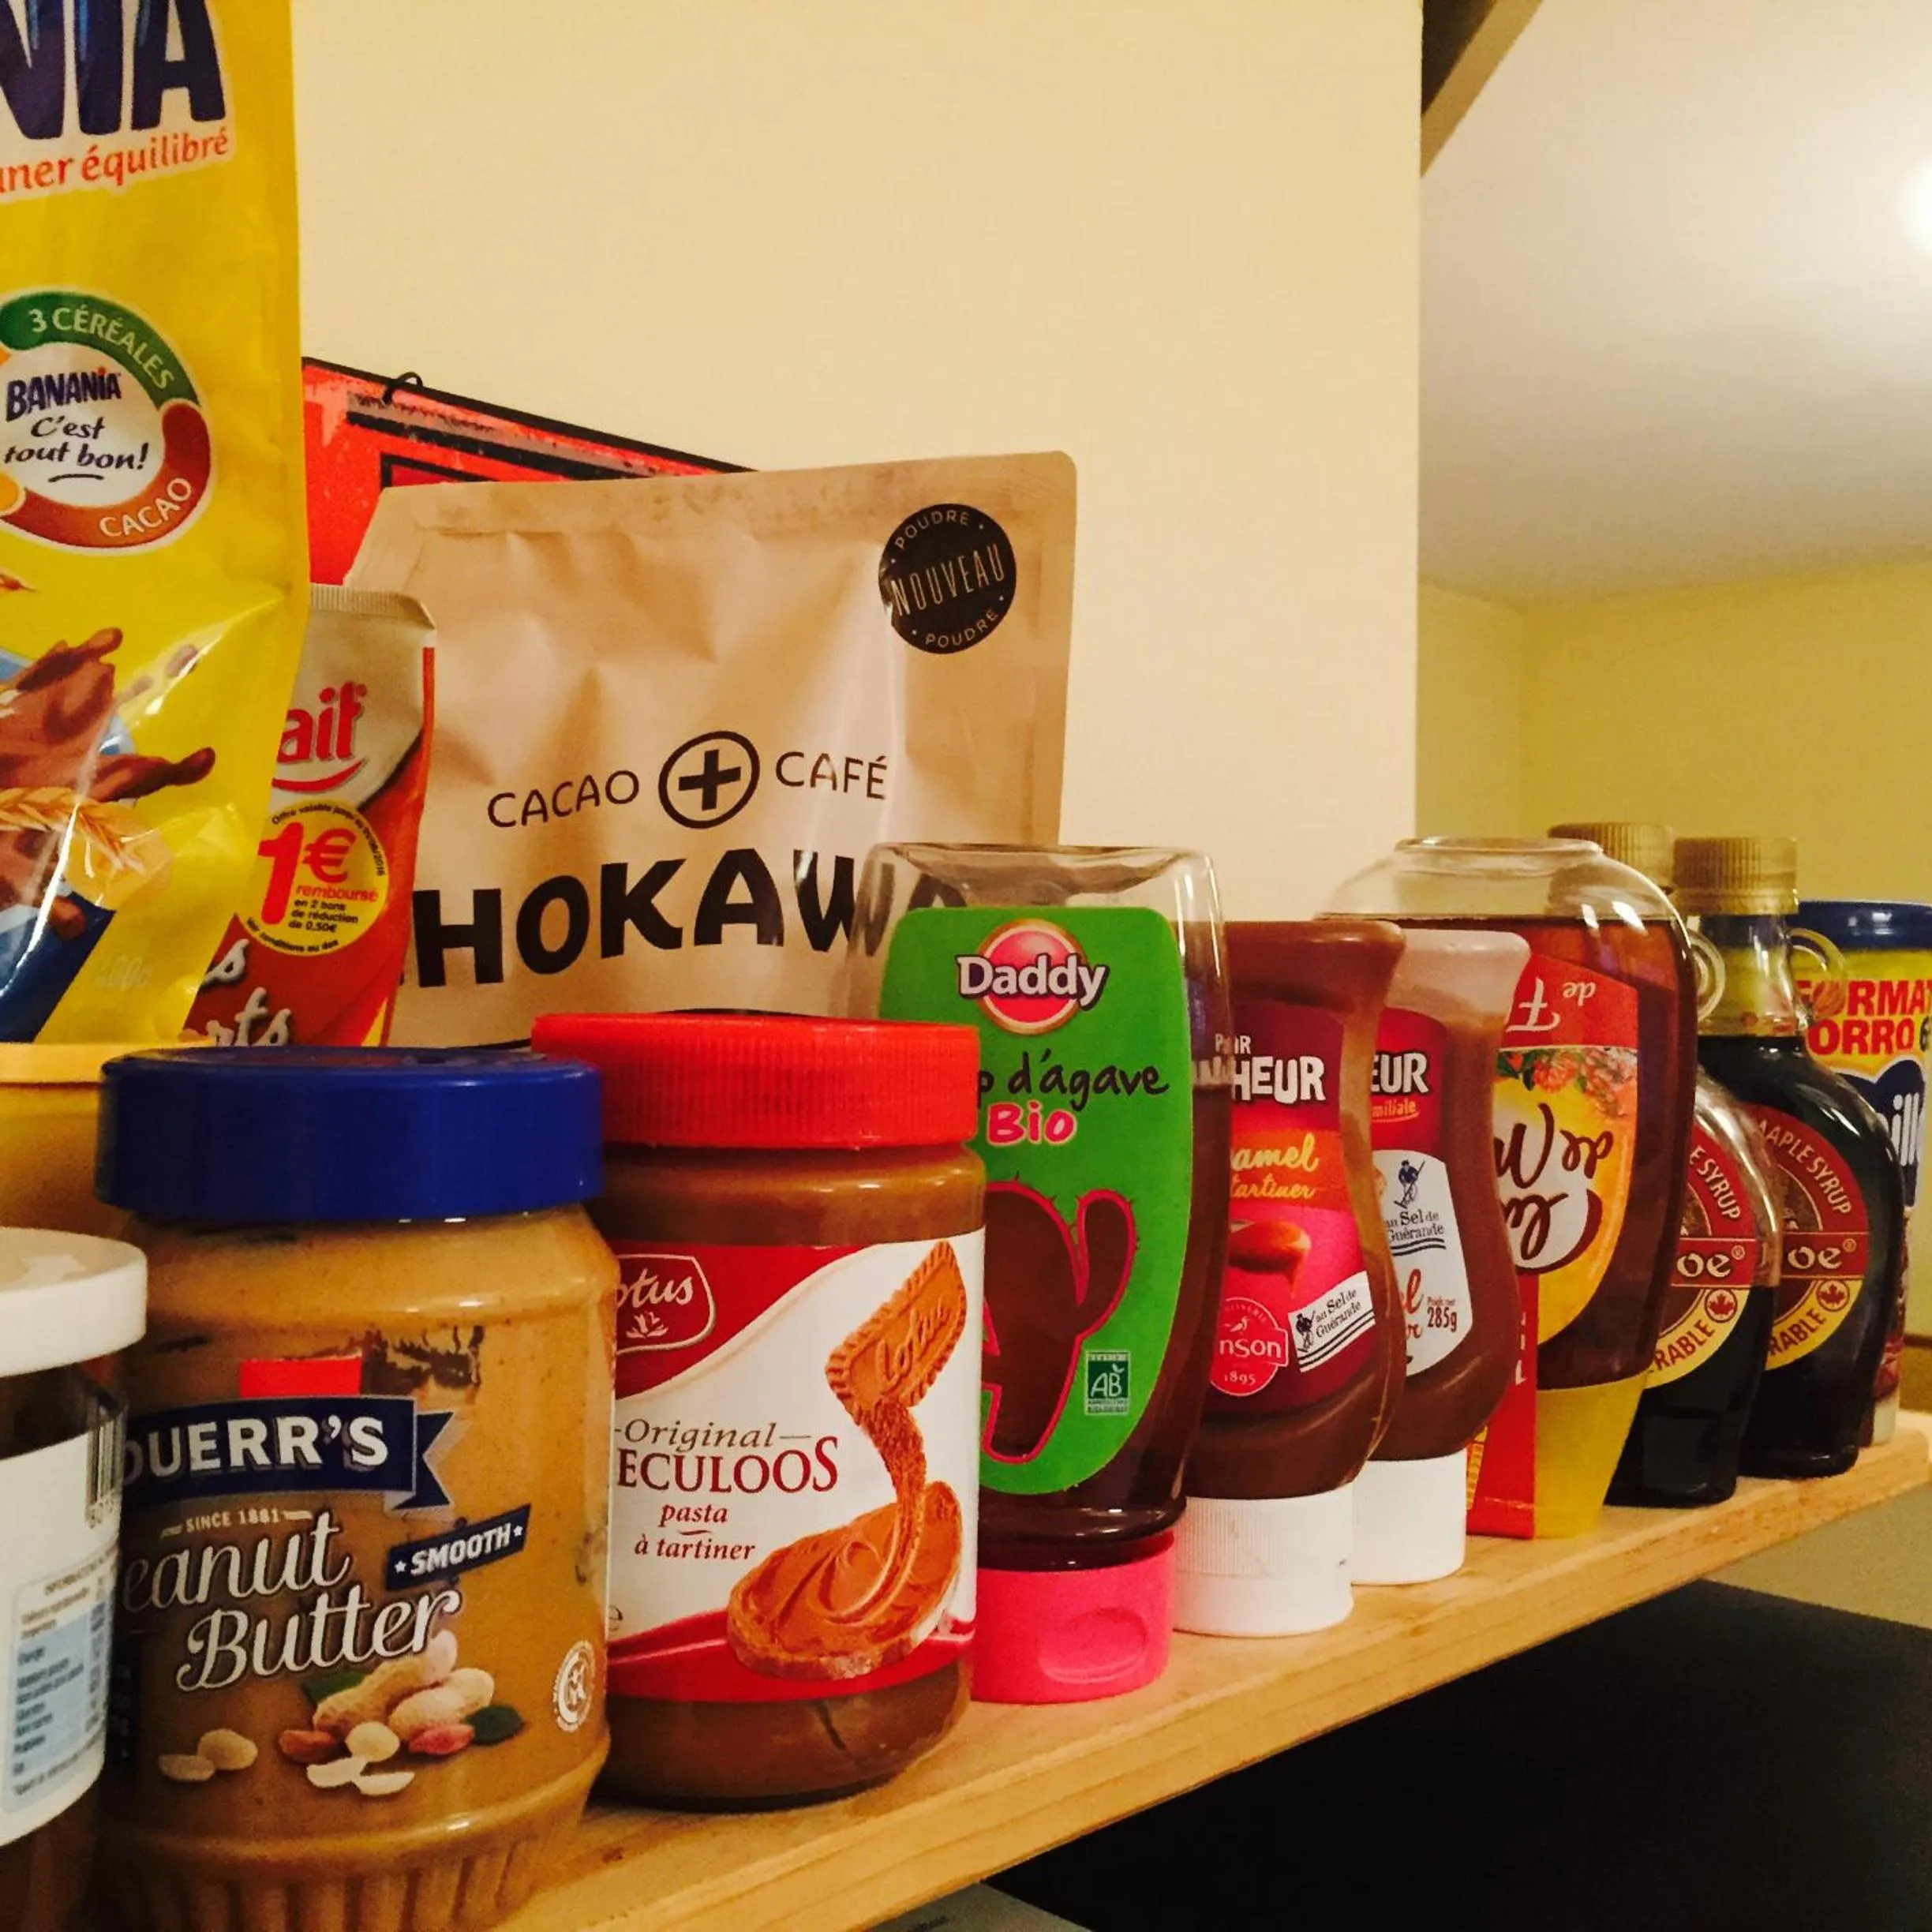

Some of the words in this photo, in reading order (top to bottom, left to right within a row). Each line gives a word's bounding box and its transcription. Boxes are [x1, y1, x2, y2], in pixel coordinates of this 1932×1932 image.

[81, 126, 228, 186] équilibré
[28, 309, 47, 332] 3
[52, 305, 174, 389] CÉRÉALES
[31, 416, 105, 439] C'est
[3, 441, 70, 464] tout
[77, 443, 149, 469] bon!
[99, 477, 192, 537] CACAO
[895, 510, 970, 550] POUDRE
[890, 543, 1005, 616] NOUVEAU
[926, 608, 999, 647] POUDRE
[487, 770, 639, 828] CACAO
[775, 751, 887, 800] CAFÉ
[258, 822, 357, 925] 1€
[956, 953, 1109, 1011] Daddy
[1008, 1048, 1170, 1111] d'agave
[987, 1099, 1077, 1146] Bio
[1696, 1158, 1741, 1221] SYRUP
[1805, 1153, 1854, 1216] SYRUP
[1399, 1209, 1424, 1226] Sel
[1425, 1210, 1440, 1222] de
[1316, 1301, 1361, 1339] Guérande
[1327, 1292, 1346, 1314] Sel
[1345, 1289, 1358, 1303] de
[1427, 1306, 1458, 1333] 285g
[1219, 1339, 1282, 1359] nson
[1655, 1319, 1715, 1372] RABLE
[1091, 1372, 1122, 1397] AB
[1224, 1370, 1256, 1387] 1895
[624, 1418, 777, 1453] Original
[617, 1436, 839, 1494] ECULOOS
[185, 1512, 231, 1533] SINCE
[658, 1503, 728, 1527] pasta
[122, 1511, 350, 1612] eanut
[410, 1526, 511, 1576] SMOOTH
[635, 1534, 649, 1555] à
[657, 1538, 755, 1560] tartiner
[176, 1586, 462, 1692] Butter
